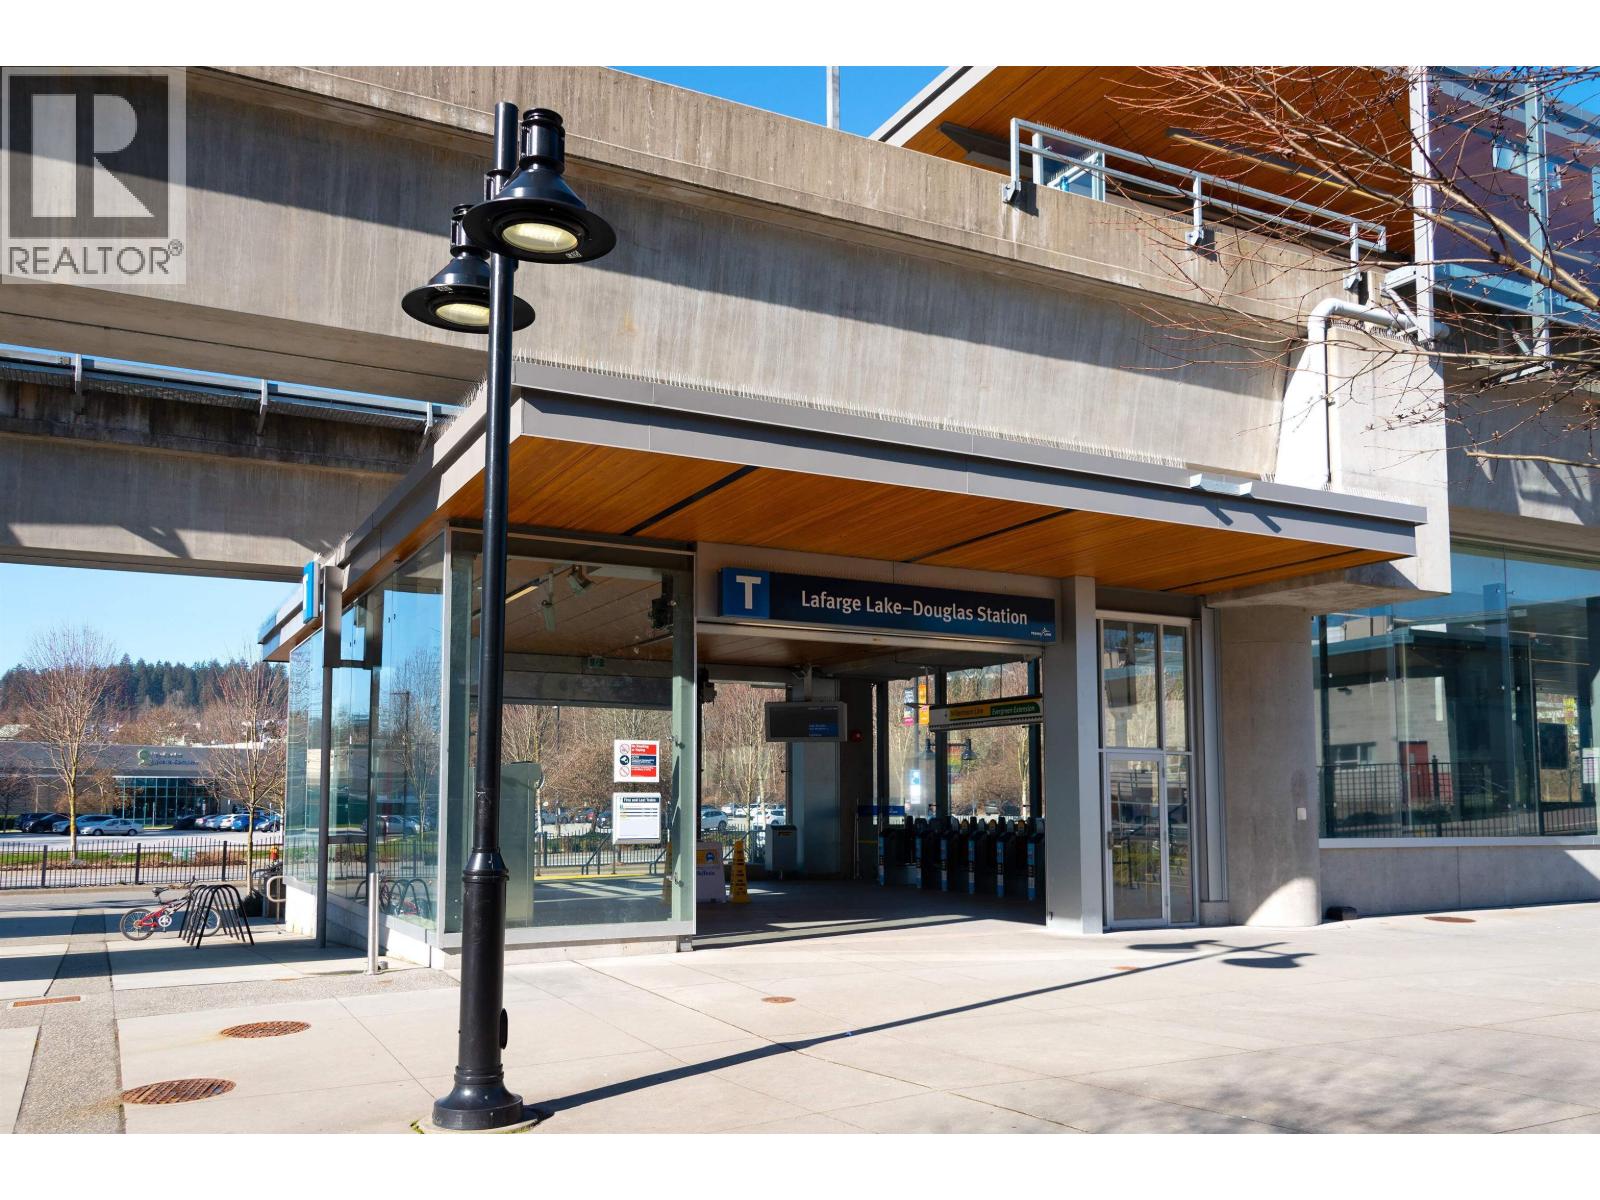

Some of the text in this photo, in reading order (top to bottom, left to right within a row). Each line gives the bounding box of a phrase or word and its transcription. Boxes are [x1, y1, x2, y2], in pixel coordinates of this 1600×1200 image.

[736, 575, 762, 610] T
[801, 590, 861, 614] Lafarge
[977, 606, 1028, 625] Station
